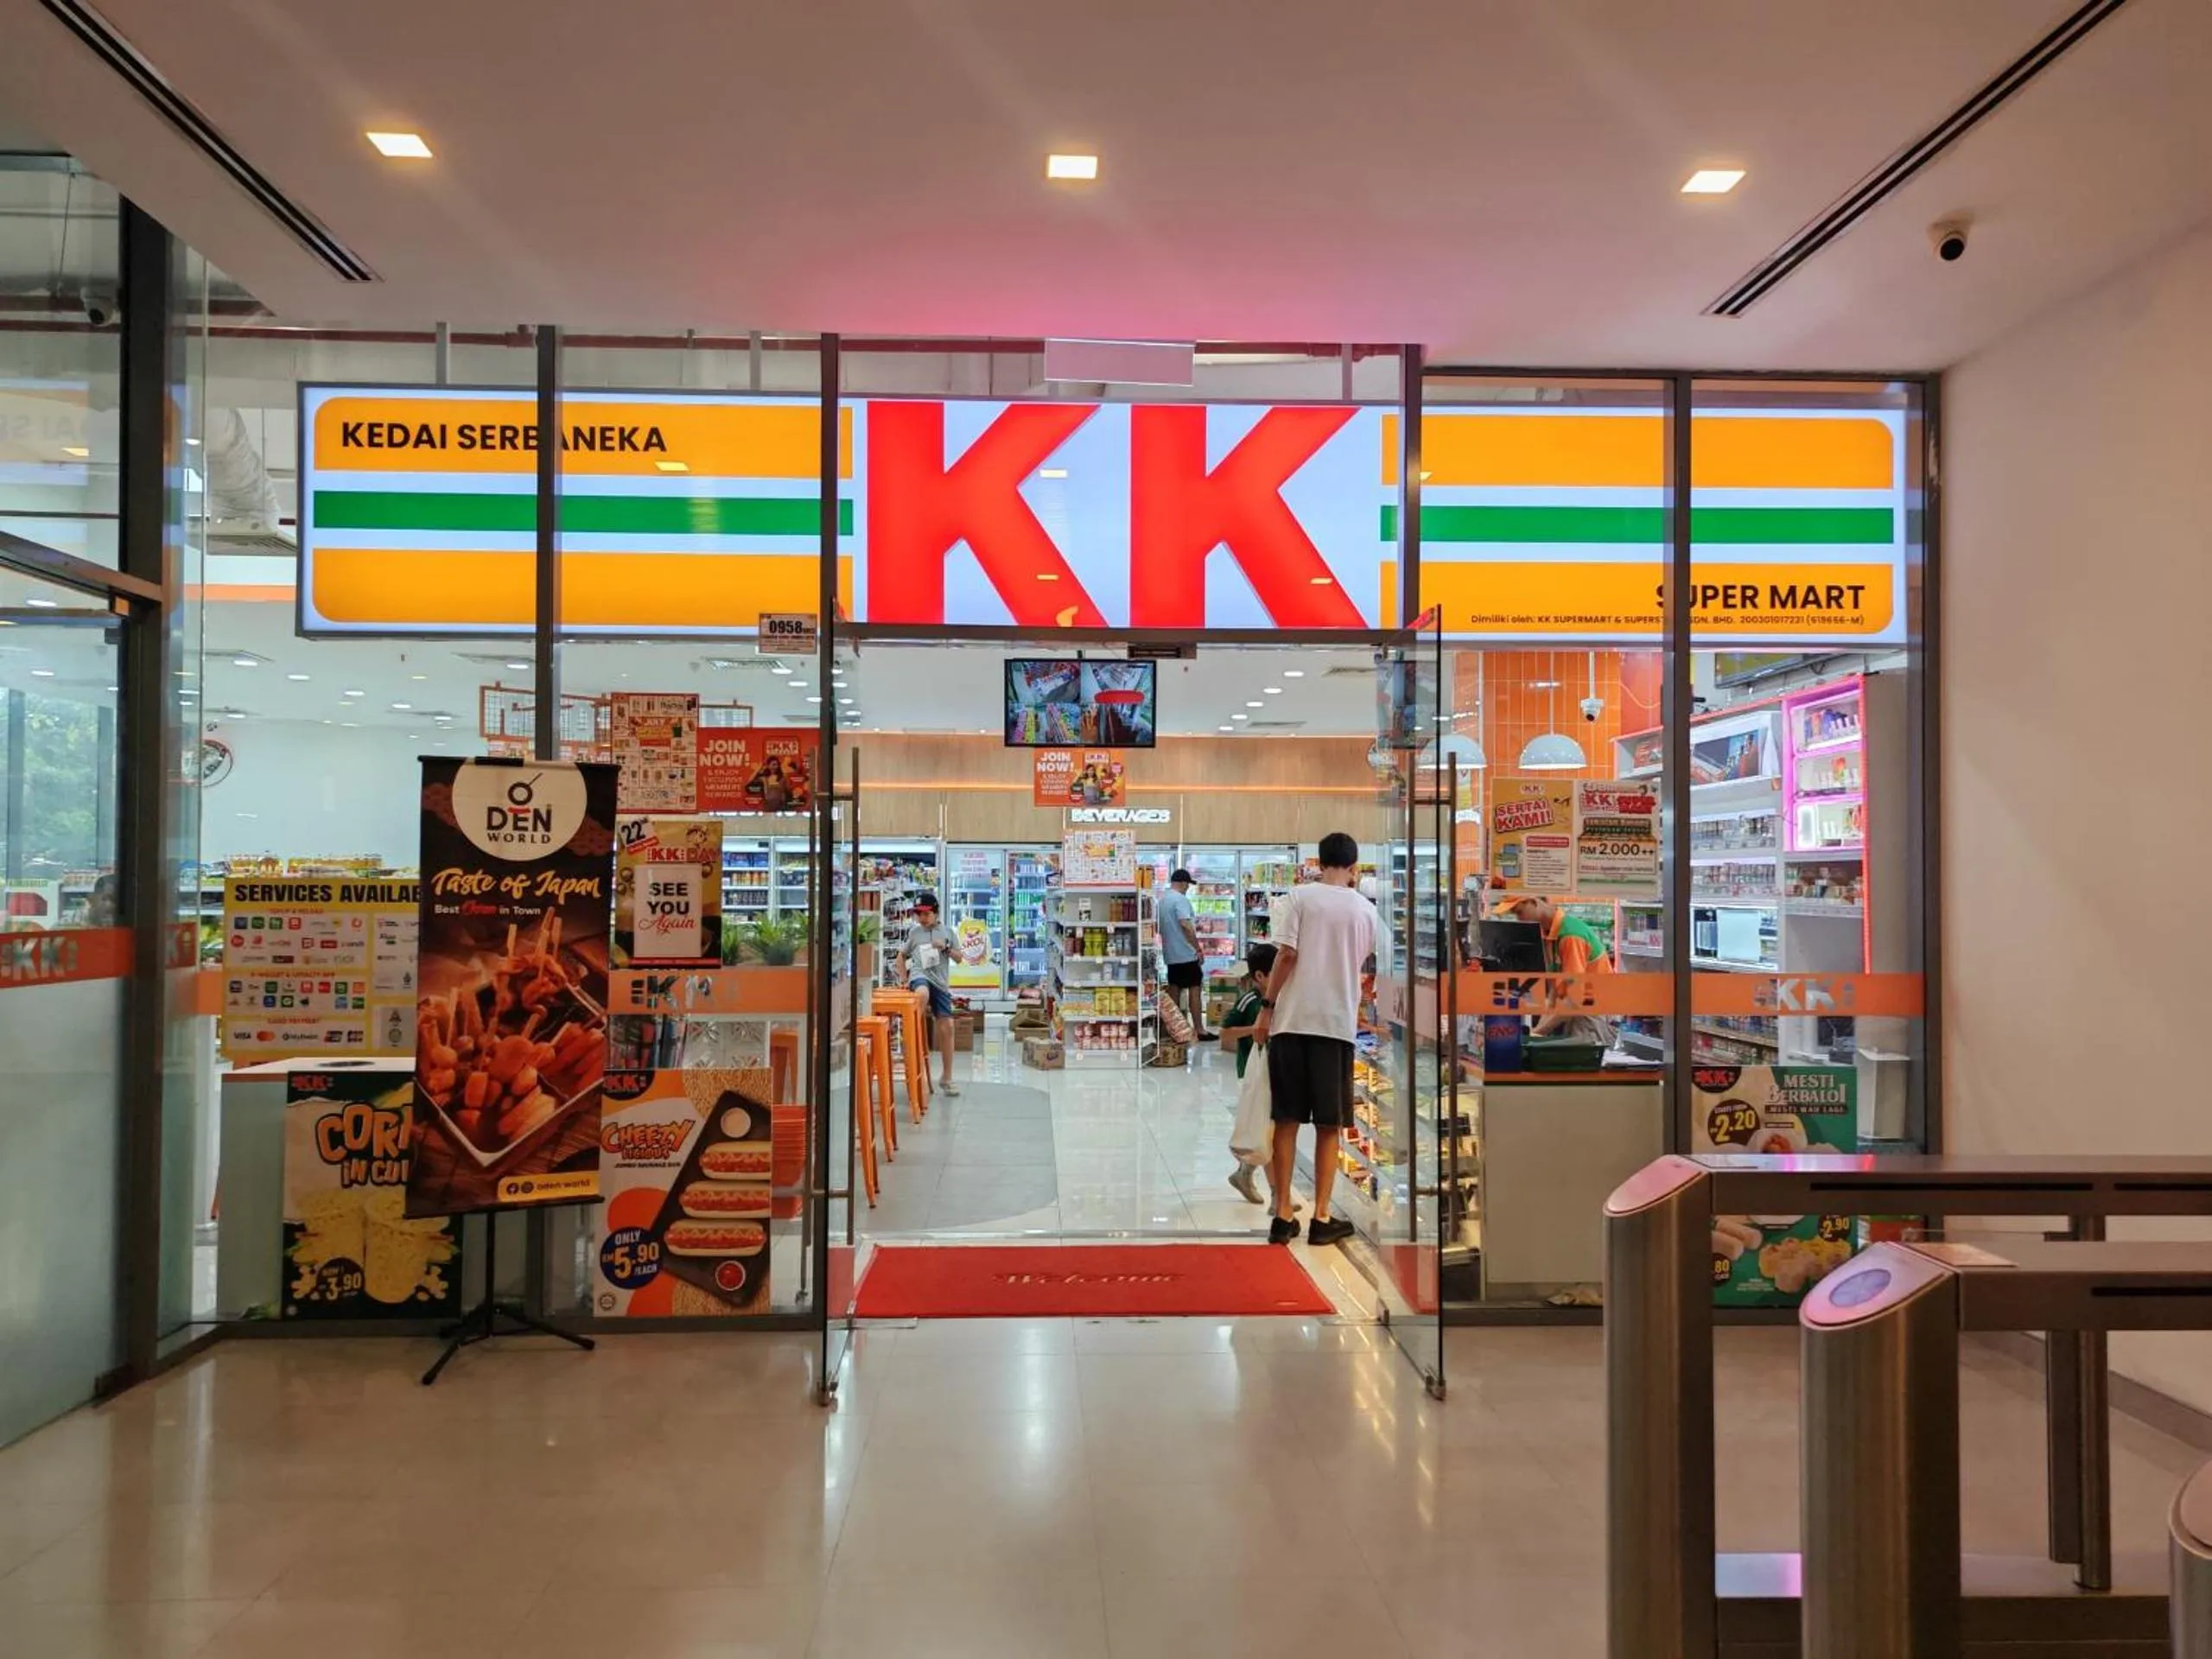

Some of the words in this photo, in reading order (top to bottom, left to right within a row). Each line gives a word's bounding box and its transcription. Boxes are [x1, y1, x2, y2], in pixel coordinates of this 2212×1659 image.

[341, 422, 448, 450] KEDAI
[458, 423, 667, 453] SERBNEKA
[867, 401, 1370, 629] KK
[1770, 584, 1866, 609] MART
[1471, 614, 1510, 623] Dimiliki
[1554, 615, 1611, 624] SUPERMART
[769, 620, 804, 633] 0958
[704, 740, 746, 753] JOIN
[699, 753, 751, 766] NOW!
[1040, 752, 1071, 761] JOIN
[1037, 762, 1075, 772] NOW!
[1585, 793, 1612, 806] KK
[1497, 800, 1547, 817] SERTAI
[1071, 809, 1171, 823] BEVERAGES
[487, 832, 551, 844] WORLD
[652, 848, 680, 861] KK
[235, 884, 333, 902] SERVICES
[432, 868, 496, 895] Taste
[499, 874, 531, 899] of
[535, 869, 602, 905] Japan
[652, 882, 688, 896] SEE
[435, 904, 460, 914] Best
[499, 906, 510, 914] in
[513, 906, 541, 915] Town
[648, 902, 690, 915] YOU
[639, 914, 696, 935] Again
[1783, 1075, 1834, 1088] MESTI
[1715, 1110, 1756, 1142] 2.20
[601, 1119, 696, 1153] CHEEZY
[614, 1230, 641, 1246] ONLY
[614, 1242, 659, 1279] 5.90
